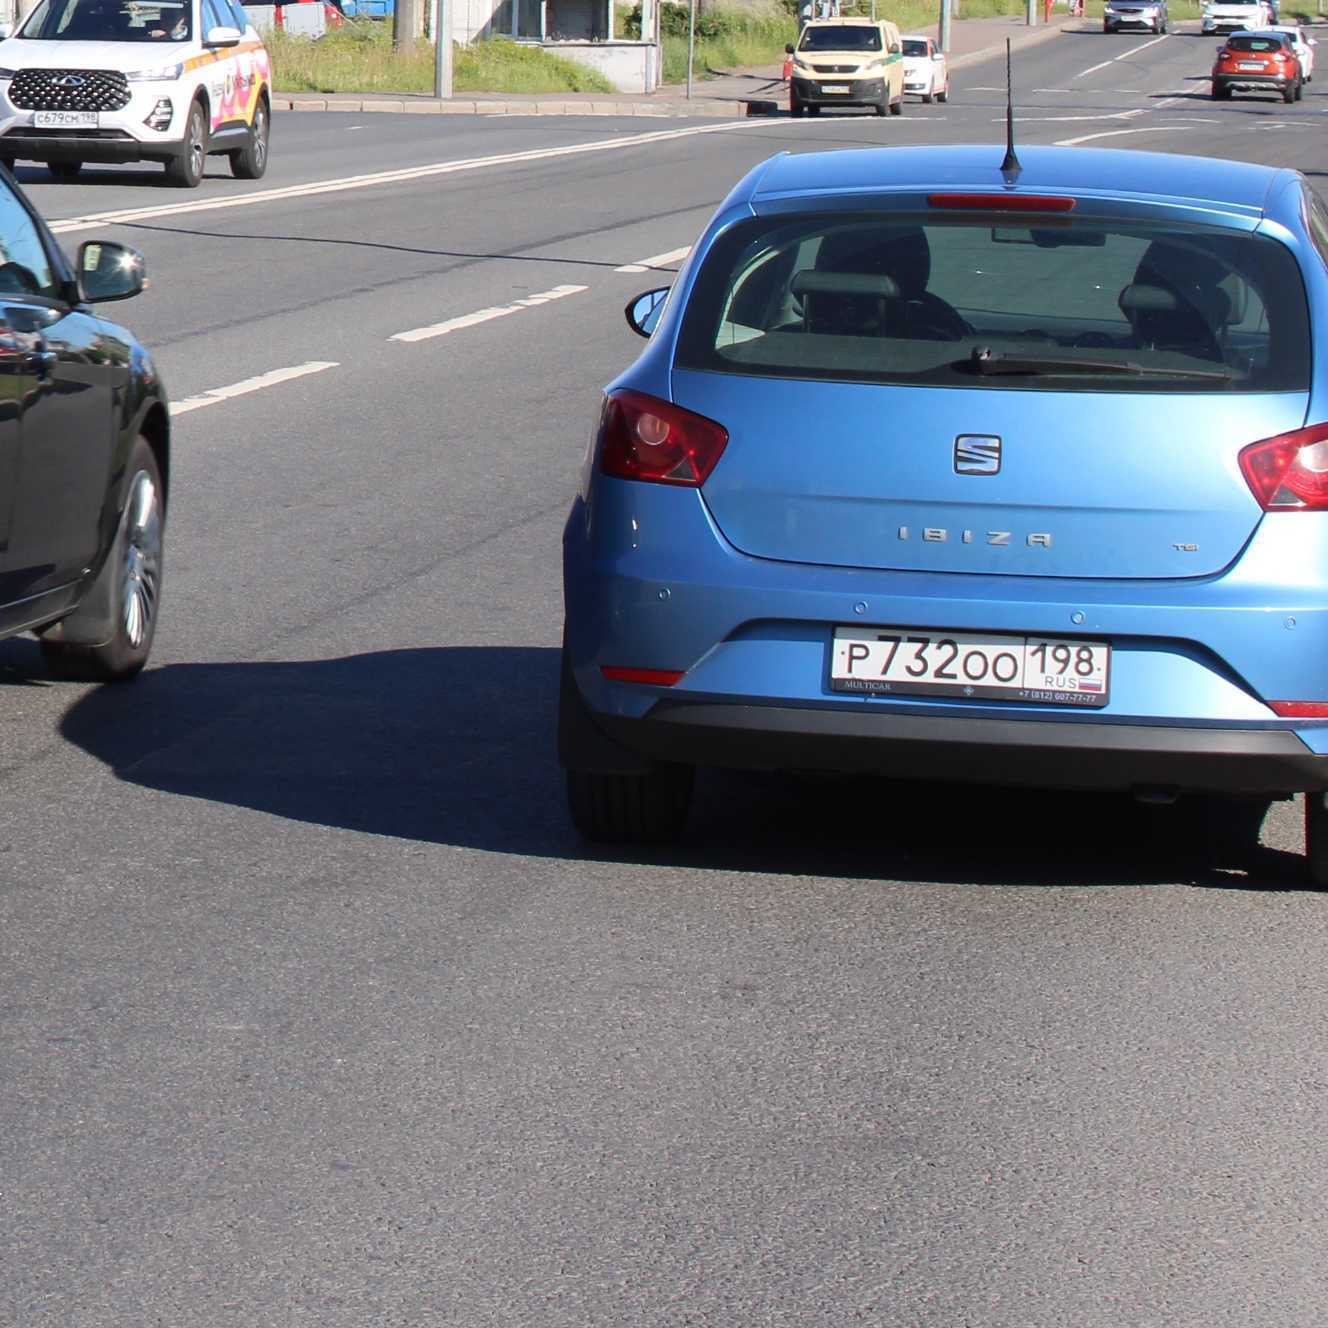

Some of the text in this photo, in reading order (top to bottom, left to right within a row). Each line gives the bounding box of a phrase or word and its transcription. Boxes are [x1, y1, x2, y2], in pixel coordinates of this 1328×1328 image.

[897, 526, 1052, 548] IBIZA
[847, 635, 1095, 683] Р732ОО 198
[844, 679, 891, 690] MULTICAR
[1044, 675, 1077, 689] RUS
